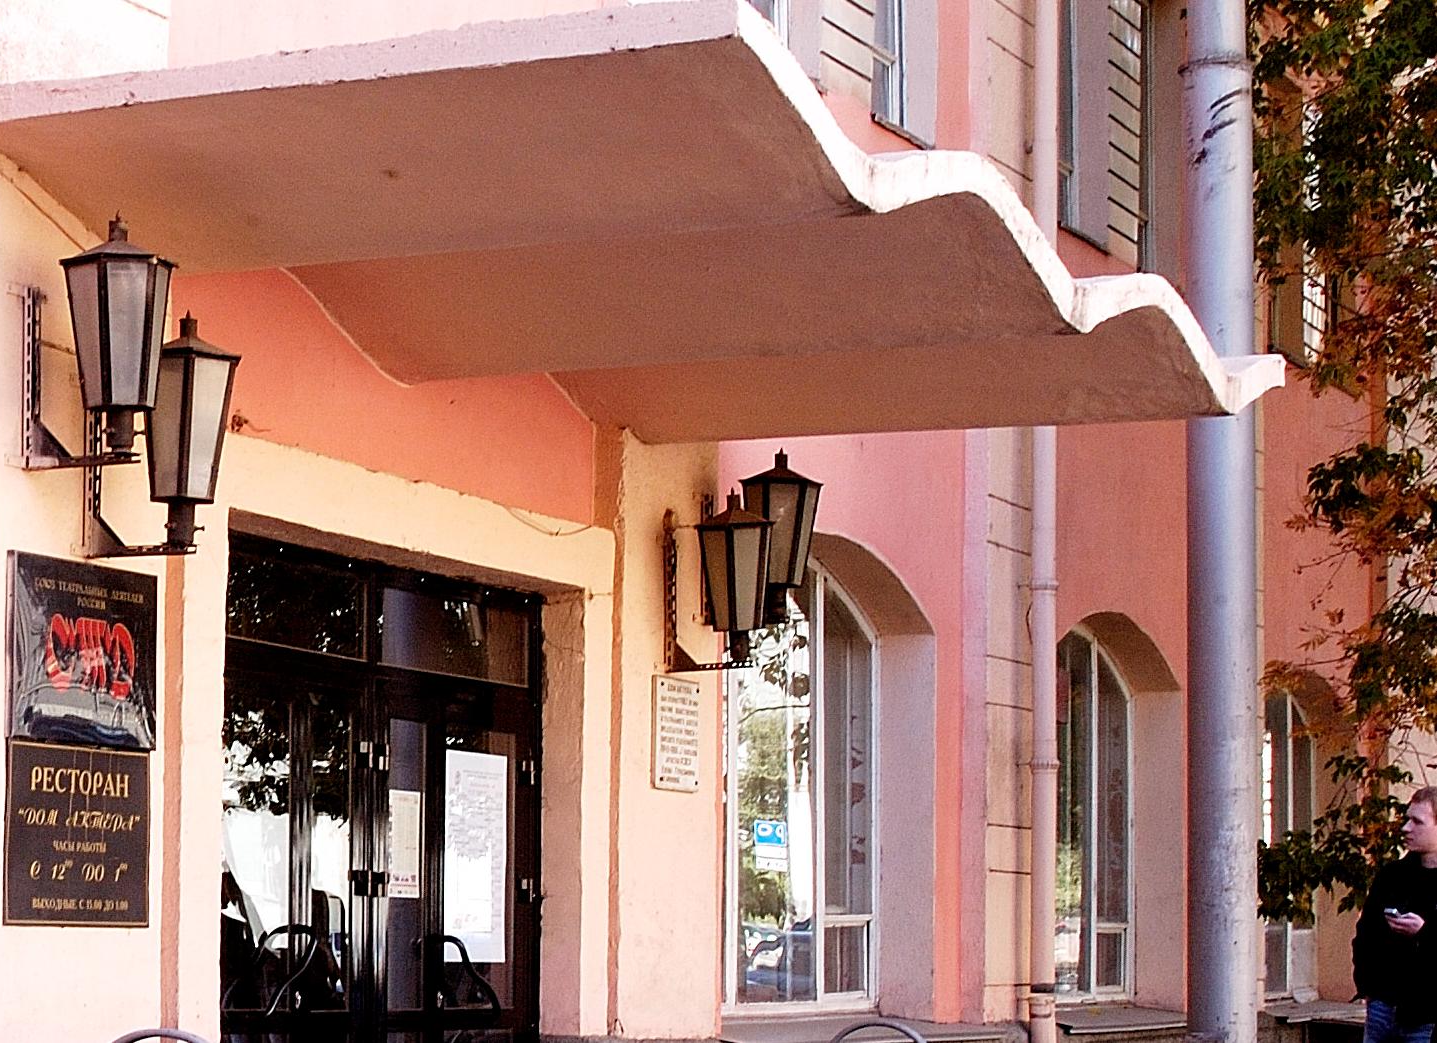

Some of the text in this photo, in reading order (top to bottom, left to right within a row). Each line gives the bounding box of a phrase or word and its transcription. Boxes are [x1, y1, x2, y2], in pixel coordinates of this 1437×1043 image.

[30, 766, 130, 798] РЕСТОРАН
[52, 840, 107, 853] ЧАСЫ РАБОТЫ
[81, 863, 105, 882] ДО
